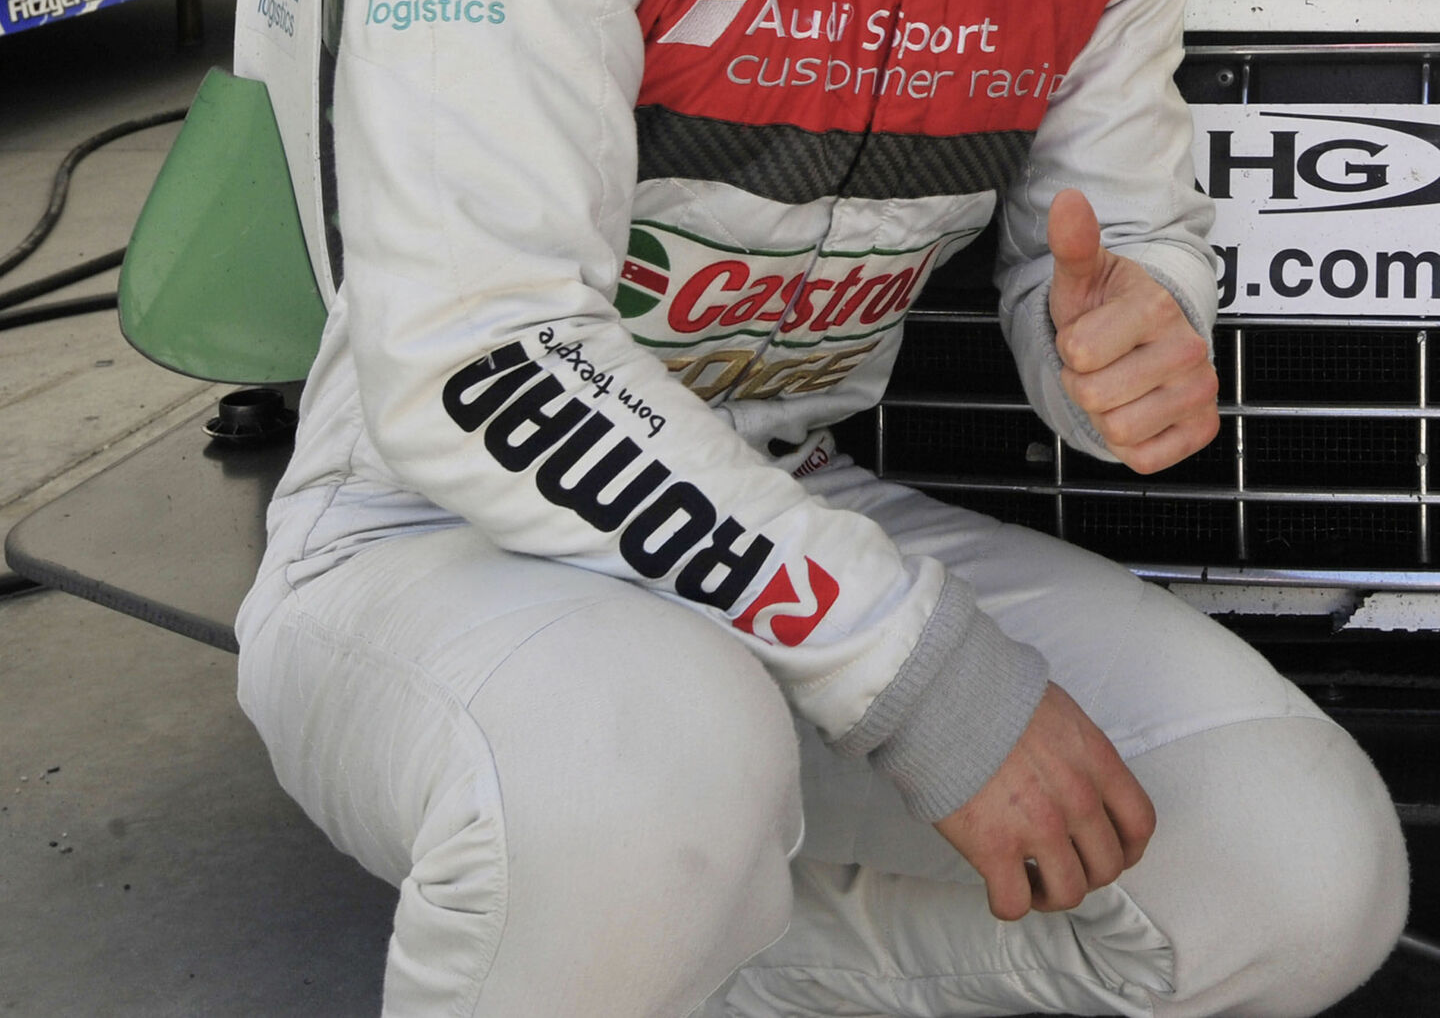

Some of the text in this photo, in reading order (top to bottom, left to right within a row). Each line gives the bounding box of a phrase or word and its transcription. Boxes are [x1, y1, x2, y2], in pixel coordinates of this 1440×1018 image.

[862, 9, 998, 59] Sport
[1195, 129, 1390, 200] HG
[667, 241, 941, 334] Castrol
[617, 387, 666, 438] born
[442, 339, 776, 612] ROMAN
